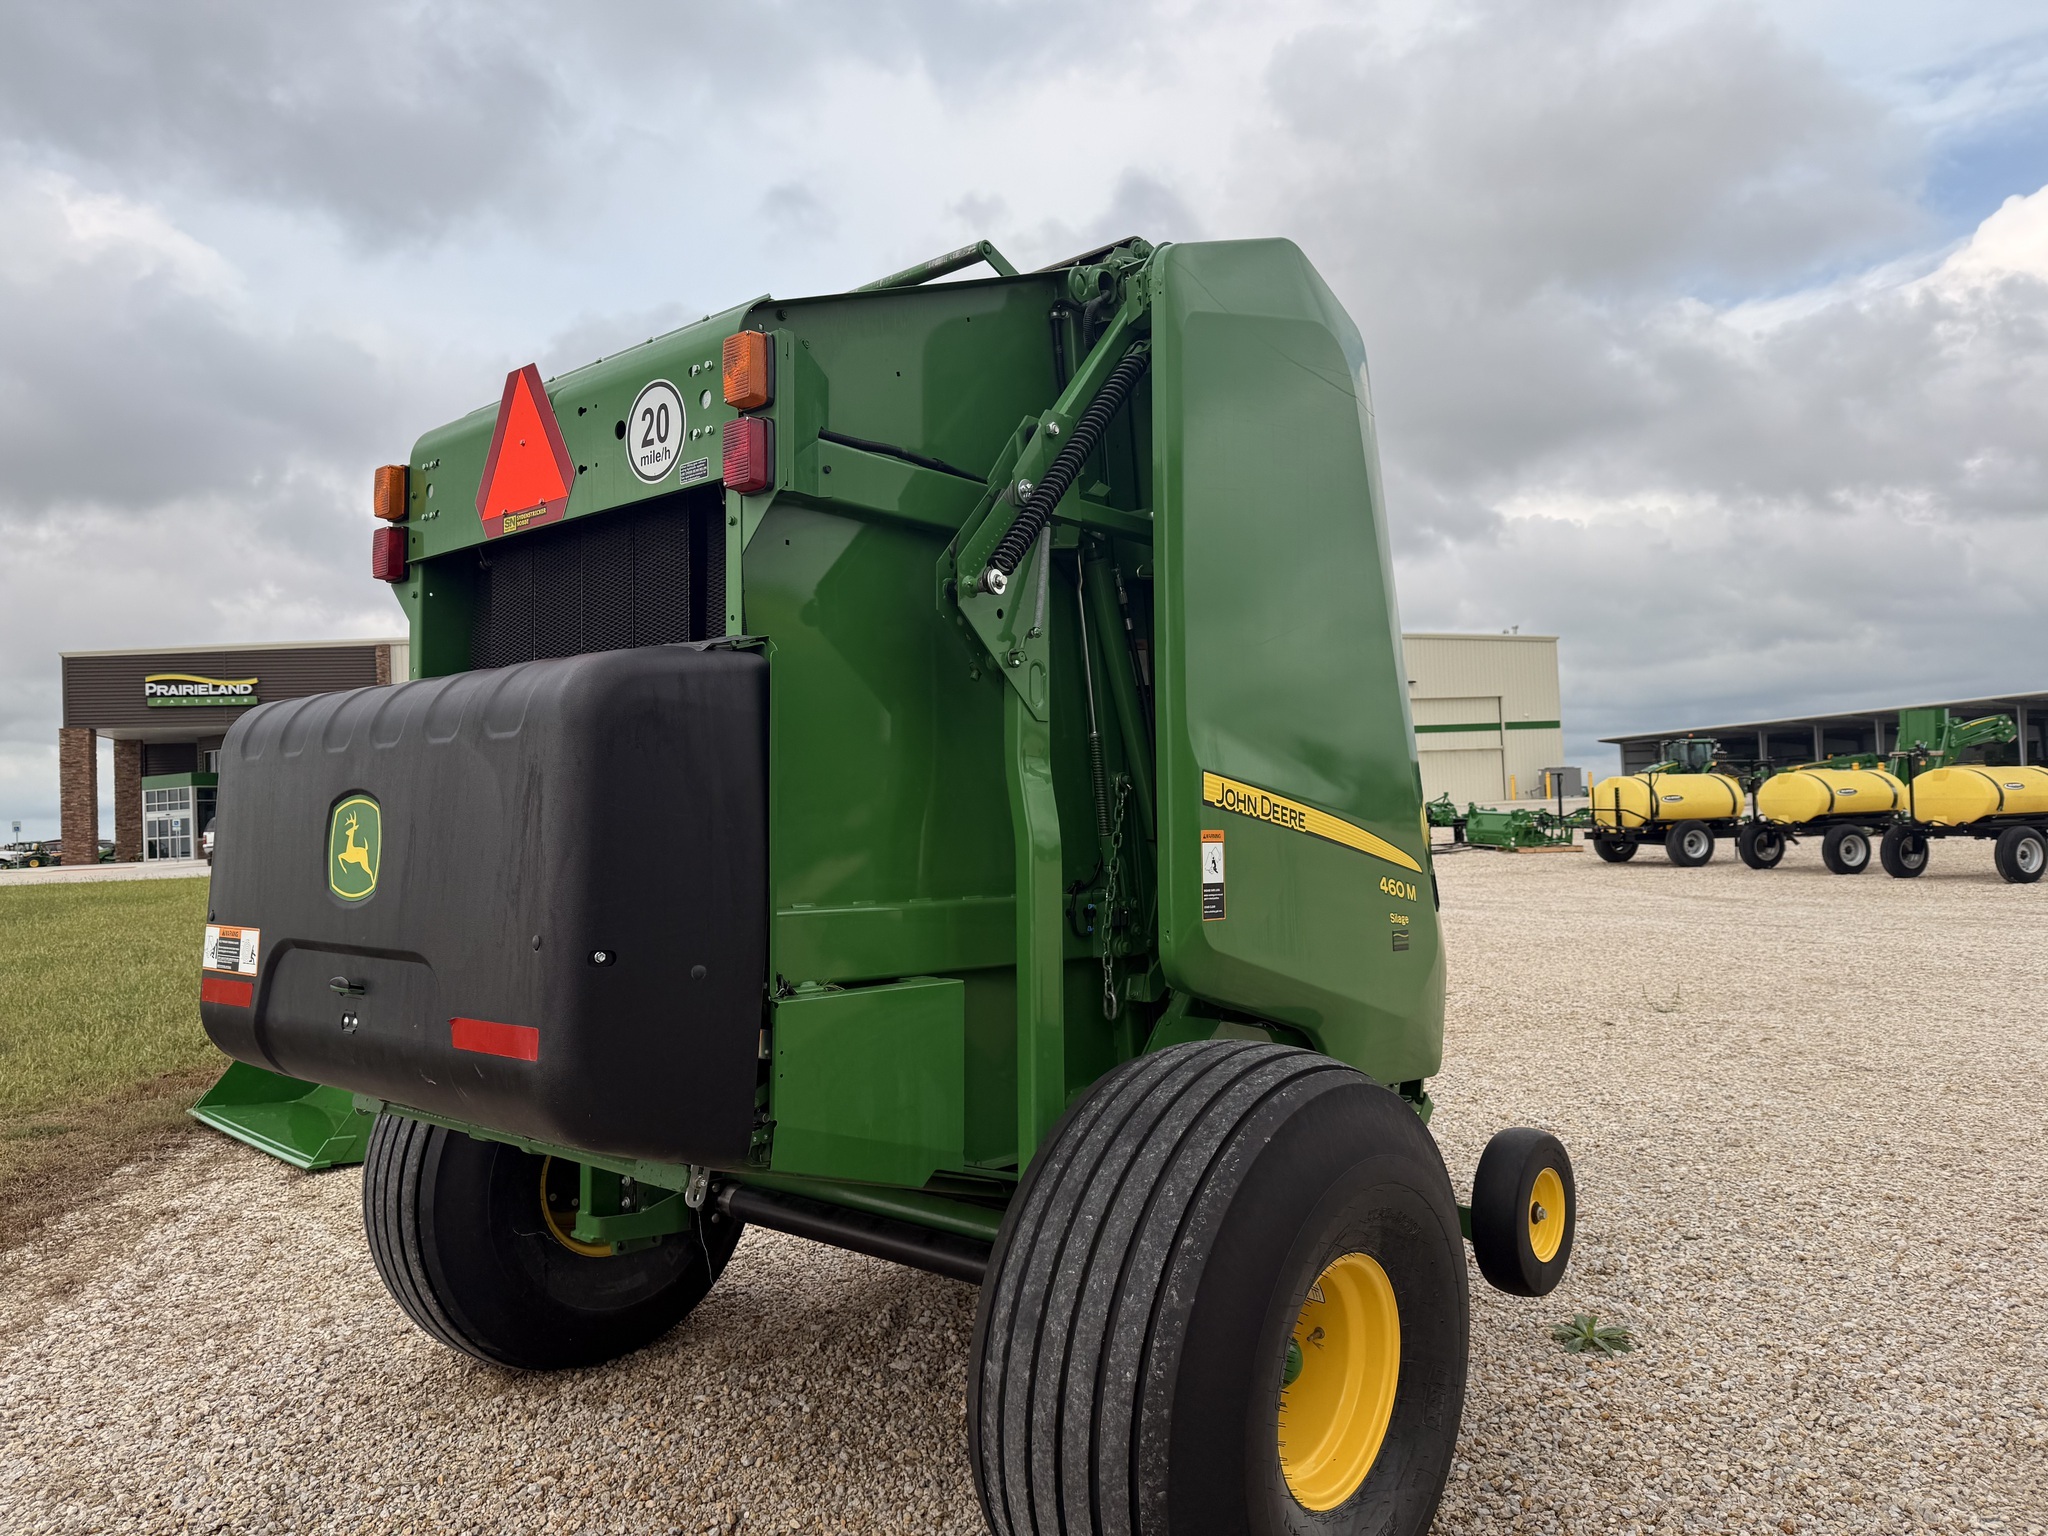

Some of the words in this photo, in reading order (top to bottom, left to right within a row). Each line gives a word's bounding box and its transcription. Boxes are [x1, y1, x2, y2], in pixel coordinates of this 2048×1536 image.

[641, 403, 670, 448] 20
[640, 446, 671, 467] mile/h
[504, 516, 516, 529] SN
[145, 683, 253, 696] PRAIRIELAND
[1215, 783, 1258, 816] JOHN
[1260, 795, 1307, 831] DEERE
[1380, 876, 1405, 898] 460
[1389, 912, 1409, 926] Silage
